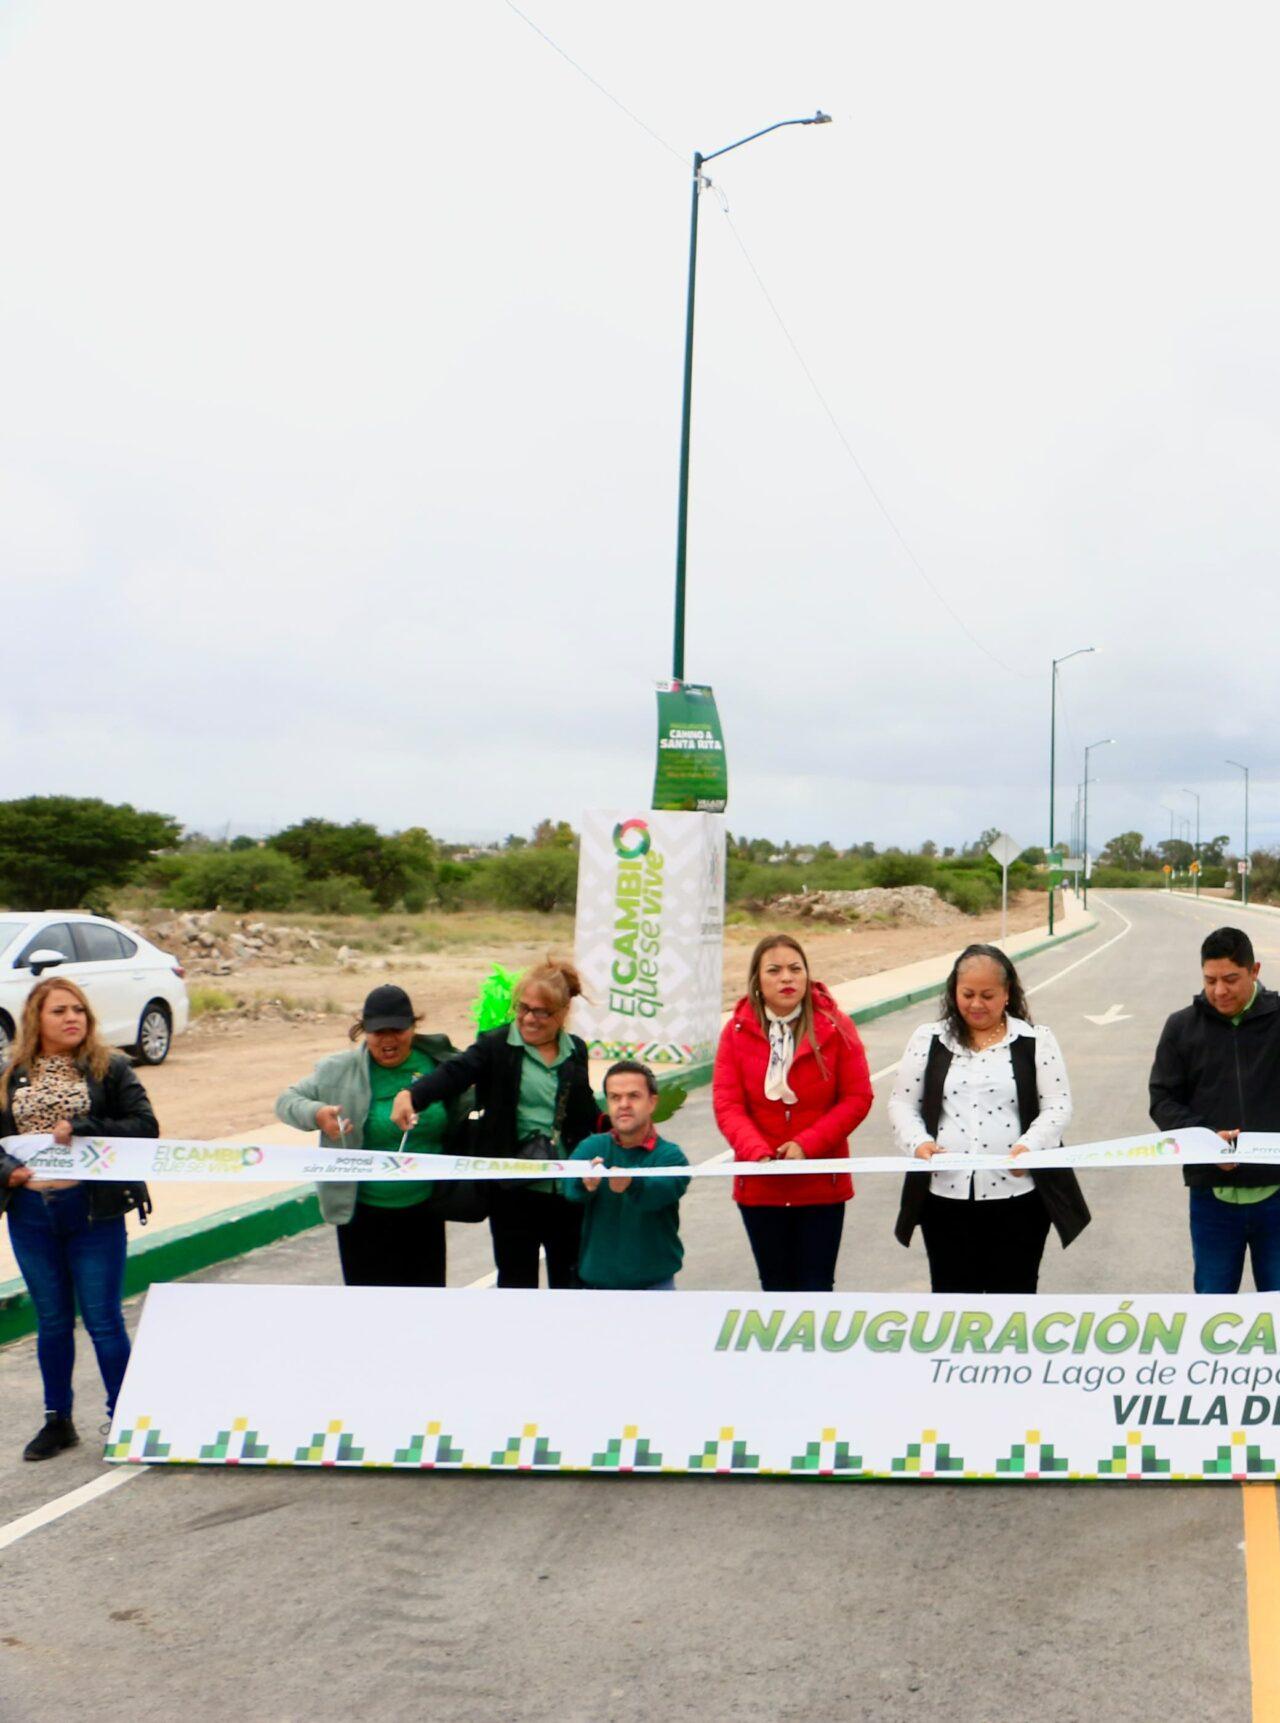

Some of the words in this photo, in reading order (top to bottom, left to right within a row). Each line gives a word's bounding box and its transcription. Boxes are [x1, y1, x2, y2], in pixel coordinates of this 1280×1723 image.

[660, 738, 695, 749] SANTA
[697, 740, 722, 750] RITA
[669, 729, 704, 739] CAMINO
[706, 730, 713, 739] A
[642, 849, 664, 915] vive
[611, 818, 651, 985] CAMBIO
[640, 919, 661, 957] se
[609, 987, 635, 1017] El
[637, 957, 664, 1018] que
[715, 1301, 1187, 1355] INAUGURACIÓN
[930, 1358, 1032, 1385] Tramo
[1042, 1359, 1126, 1393] Lago
[1135, 1359, 1177, 1385] de
[1112, 1394, 1229, 1426] VILLA
